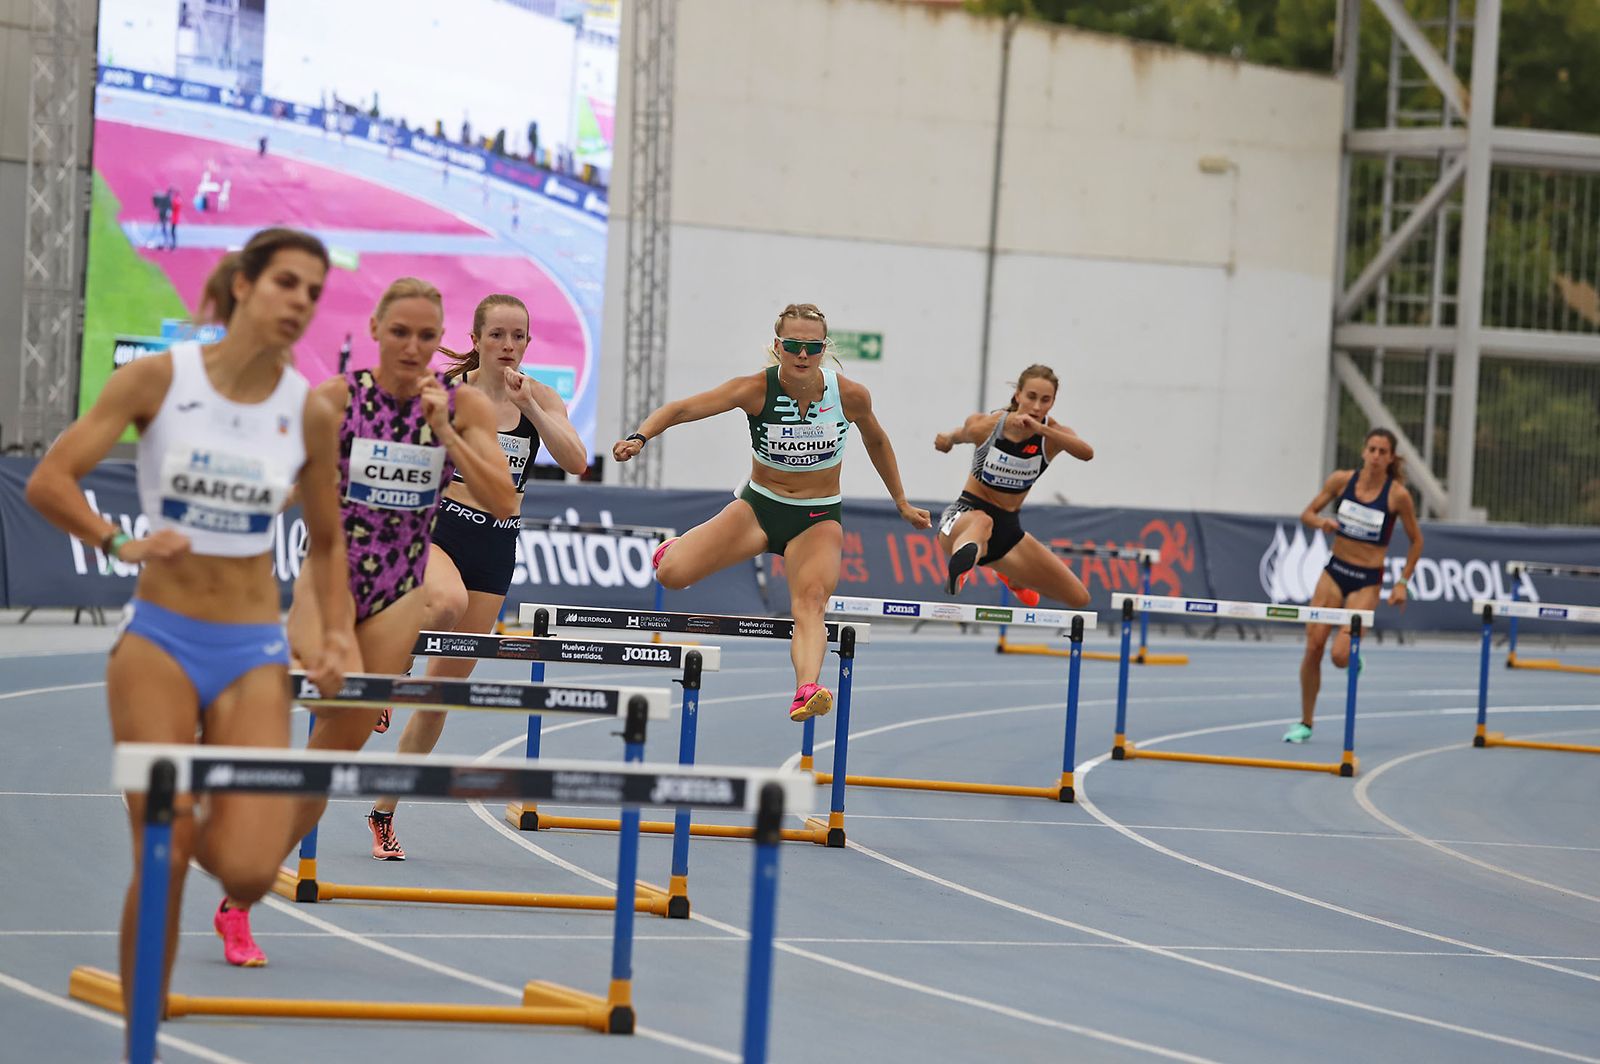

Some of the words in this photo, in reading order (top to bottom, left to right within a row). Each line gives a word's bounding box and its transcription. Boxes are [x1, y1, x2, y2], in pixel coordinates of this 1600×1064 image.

[769, 440, 836, 451] TKACHUK
[364, 465, 432, 485] CLAES
[985, 461, 1038, 476] LEHIKOINEN
[171, 474, 273, 505] GARCIA
[446, 503, 486, 524] PRO
[578, 616, 612, 624] IBERDROLA
[739, 620, 759, 628] Huelva
[561, 643, 586, 651] Huelva
[622, 647, 672, 661] Joma
